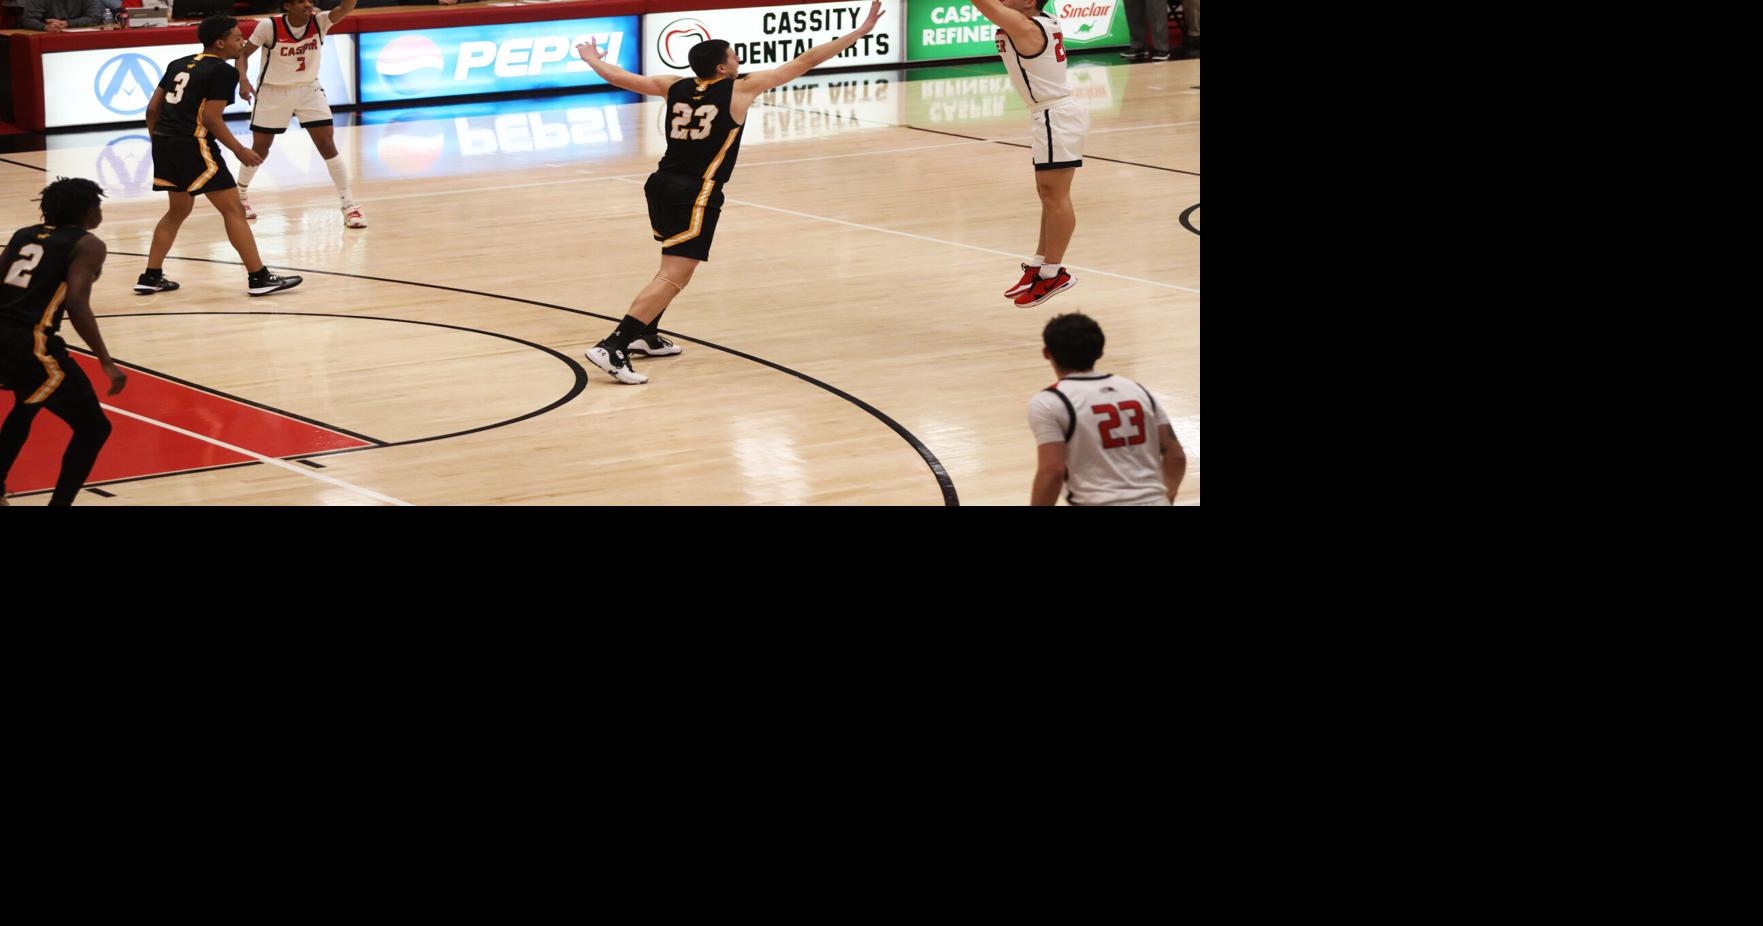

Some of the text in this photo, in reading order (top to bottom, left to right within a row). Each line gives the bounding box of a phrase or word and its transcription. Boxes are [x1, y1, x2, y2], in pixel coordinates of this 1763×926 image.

[763, 7, 861, 35] CASSITY
[931, 5, 989, 24] CASP
[1060, 3, 1111, 19] Sinclair
[922, 24, 1000, 46] REFINE
[1053, 32, 1066, 62] 2
[454, 32, 624, 81] PEPSI
[166, 72, 190, 104] 3
[670, 103, 718, 140] 23
[4, 243, 44, 288] 2
[1091, 400, 1146, 449] 23
